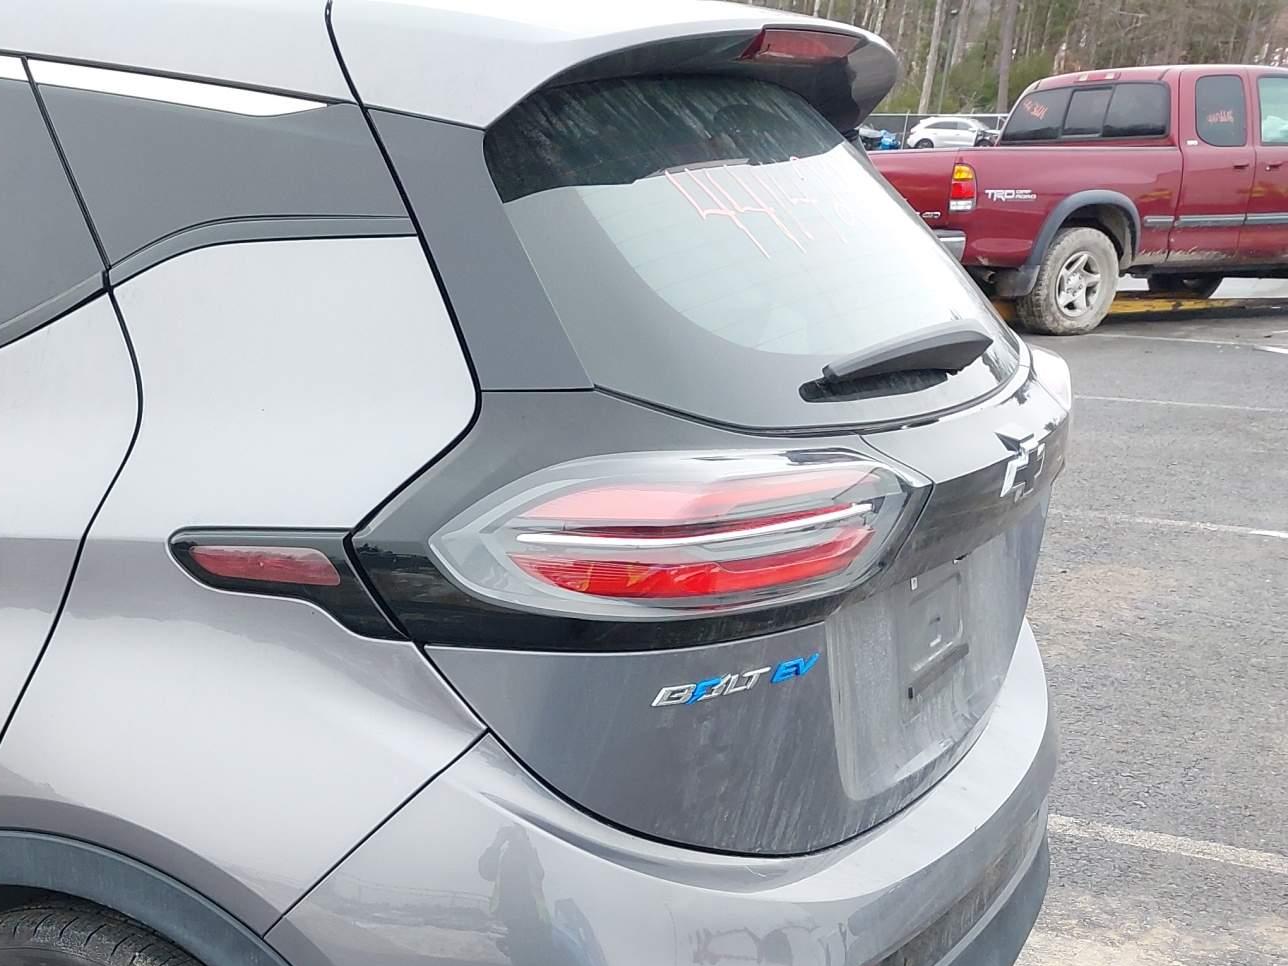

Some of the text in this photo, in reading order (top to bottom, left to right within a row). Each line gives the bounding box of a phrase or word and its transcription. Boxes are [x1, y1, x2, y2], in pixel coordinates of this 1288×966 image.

[984, 189, 1015, 202] TRD
[650, 650, 821, 707] BOLT EV
